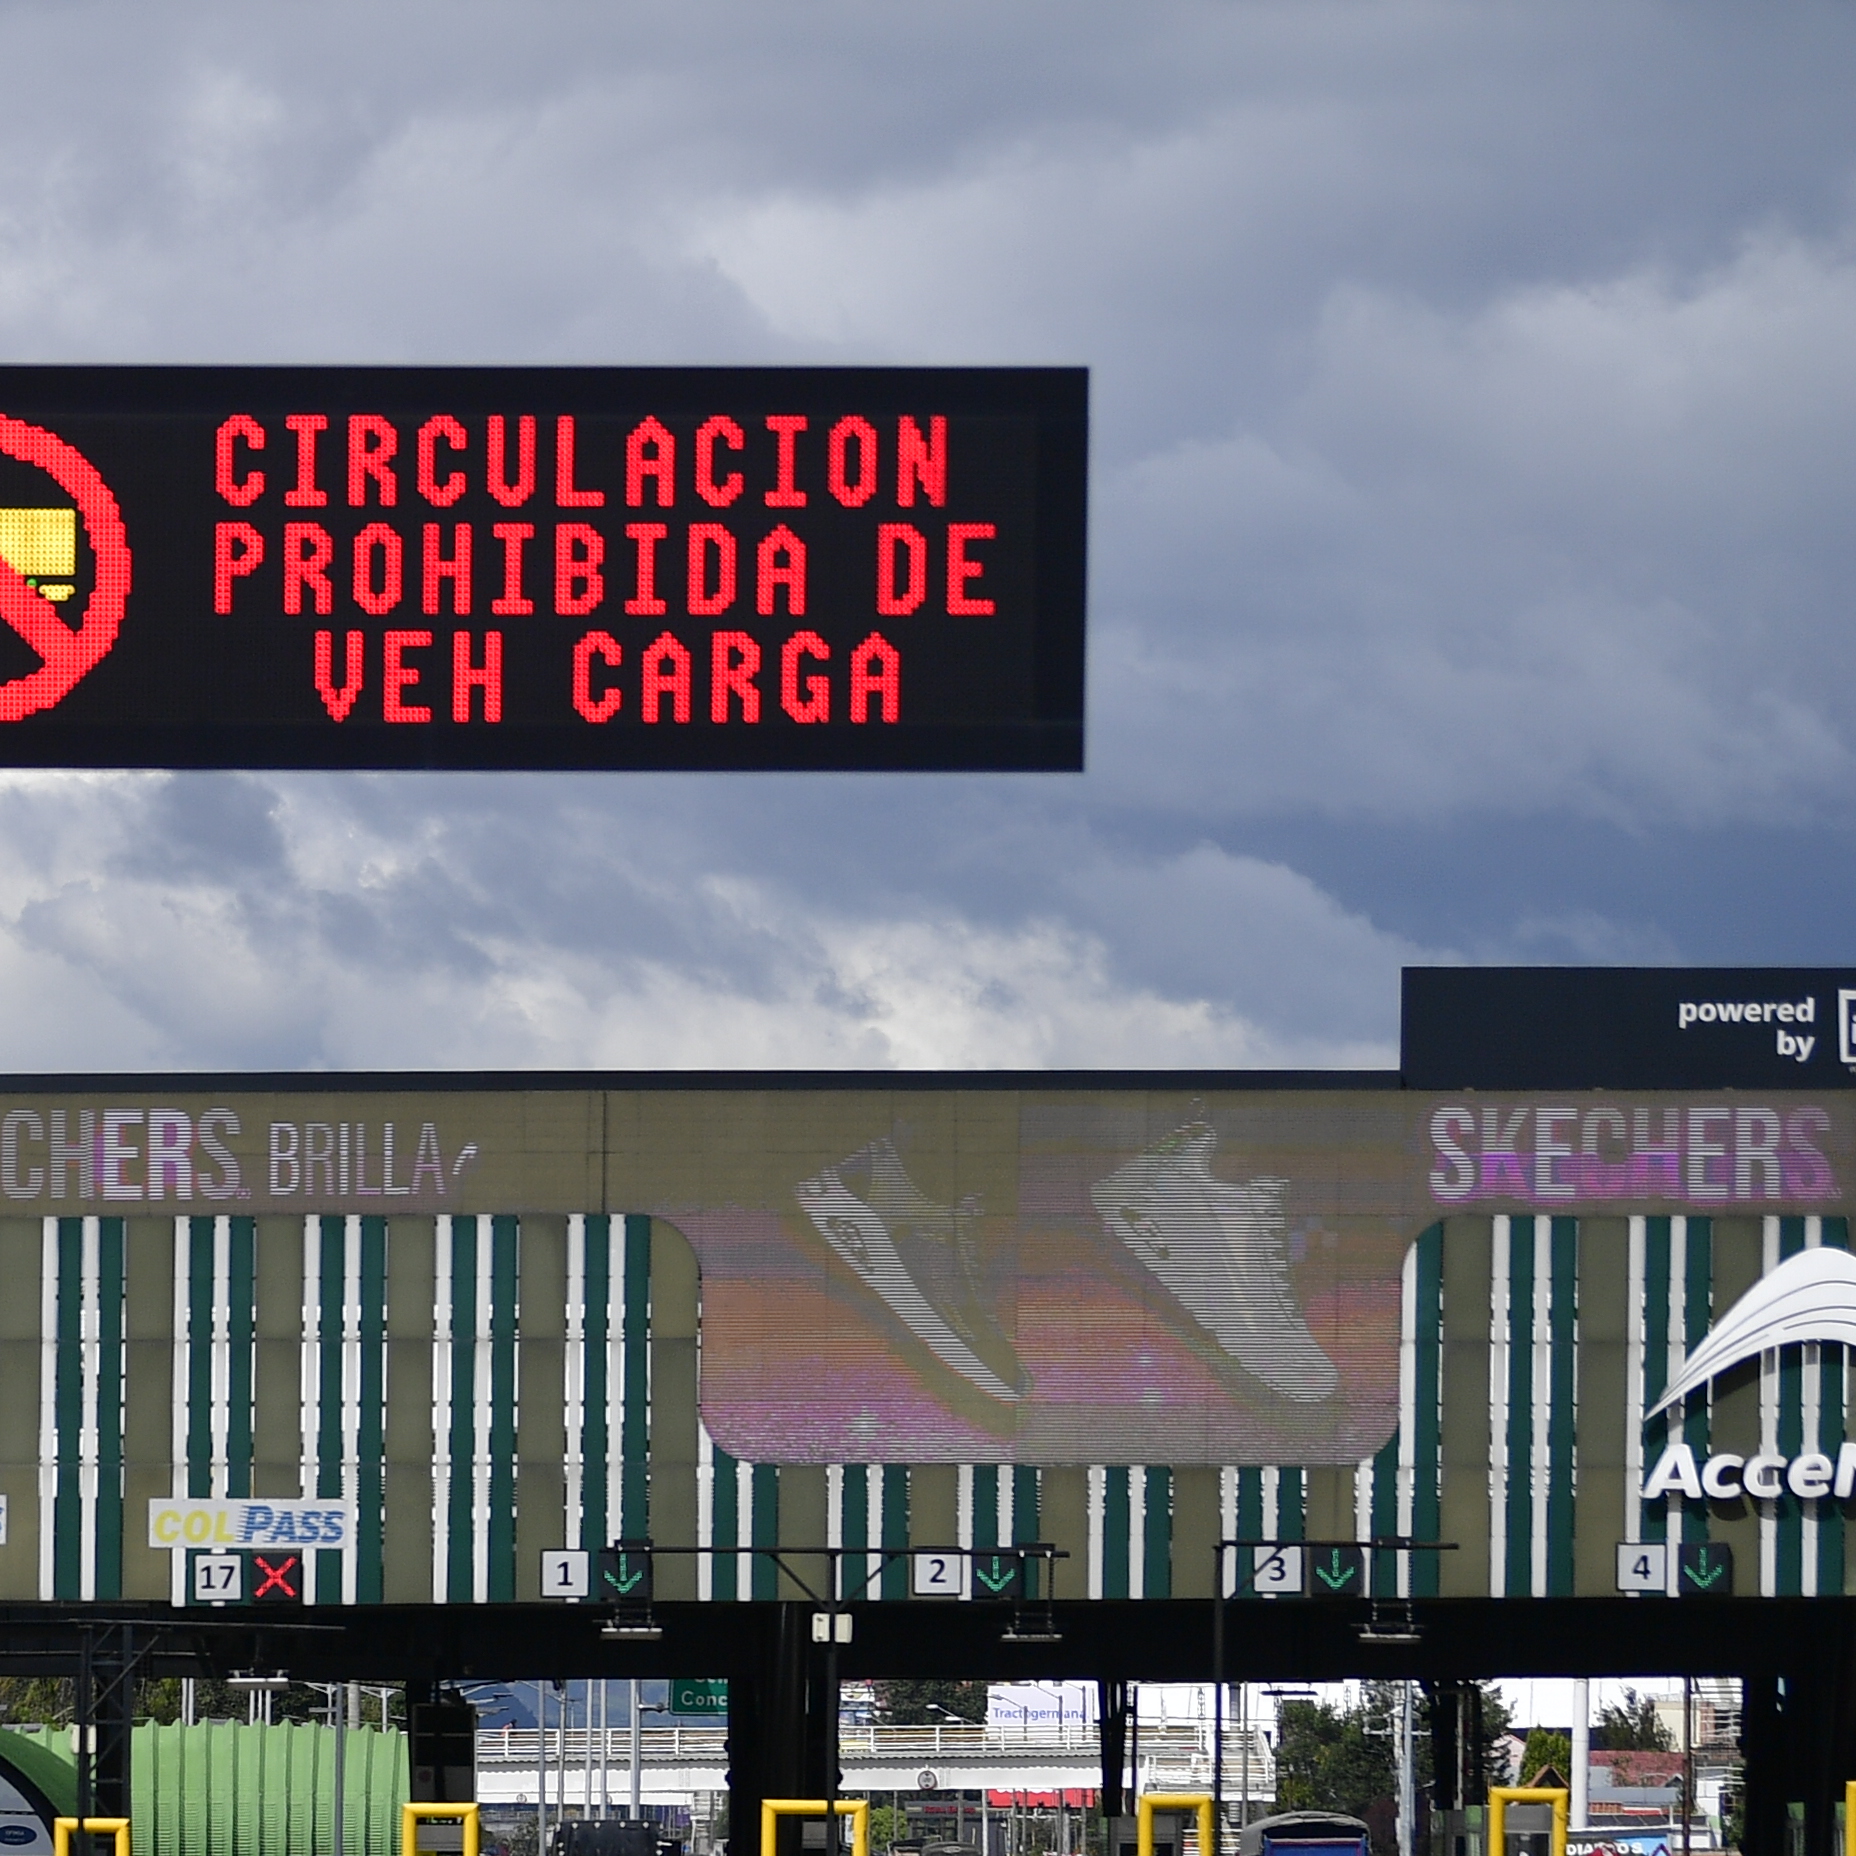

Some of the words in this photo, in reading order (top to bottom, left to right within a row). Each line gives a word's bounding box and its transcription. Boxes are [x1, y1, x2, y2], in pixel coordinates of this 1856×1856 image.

[215, 414, 947, 508] CIRCULACION
[214, 522, 807, 616] PROHIBIDA
[876, 522, 997, 616] DE
[314, 629, 503, 724] VEH
[572, 630, 900, 724] CARGA
[1678, 996, 1815, 1029] powered
[1776, 1029, 1815, 1062] by
[1429, 1106, 1833, 1200] SKECHERS
[154, 1505, 346, 1544] COLPASS
[200, 1565, 235, 1590] 17
[557, 1560, 574, 1587] 1
[929, 1558, 947, 1583] 2
[1268, 1556, 1287, 1582] 3
[1632, 1554, 1652, 1580] 4
